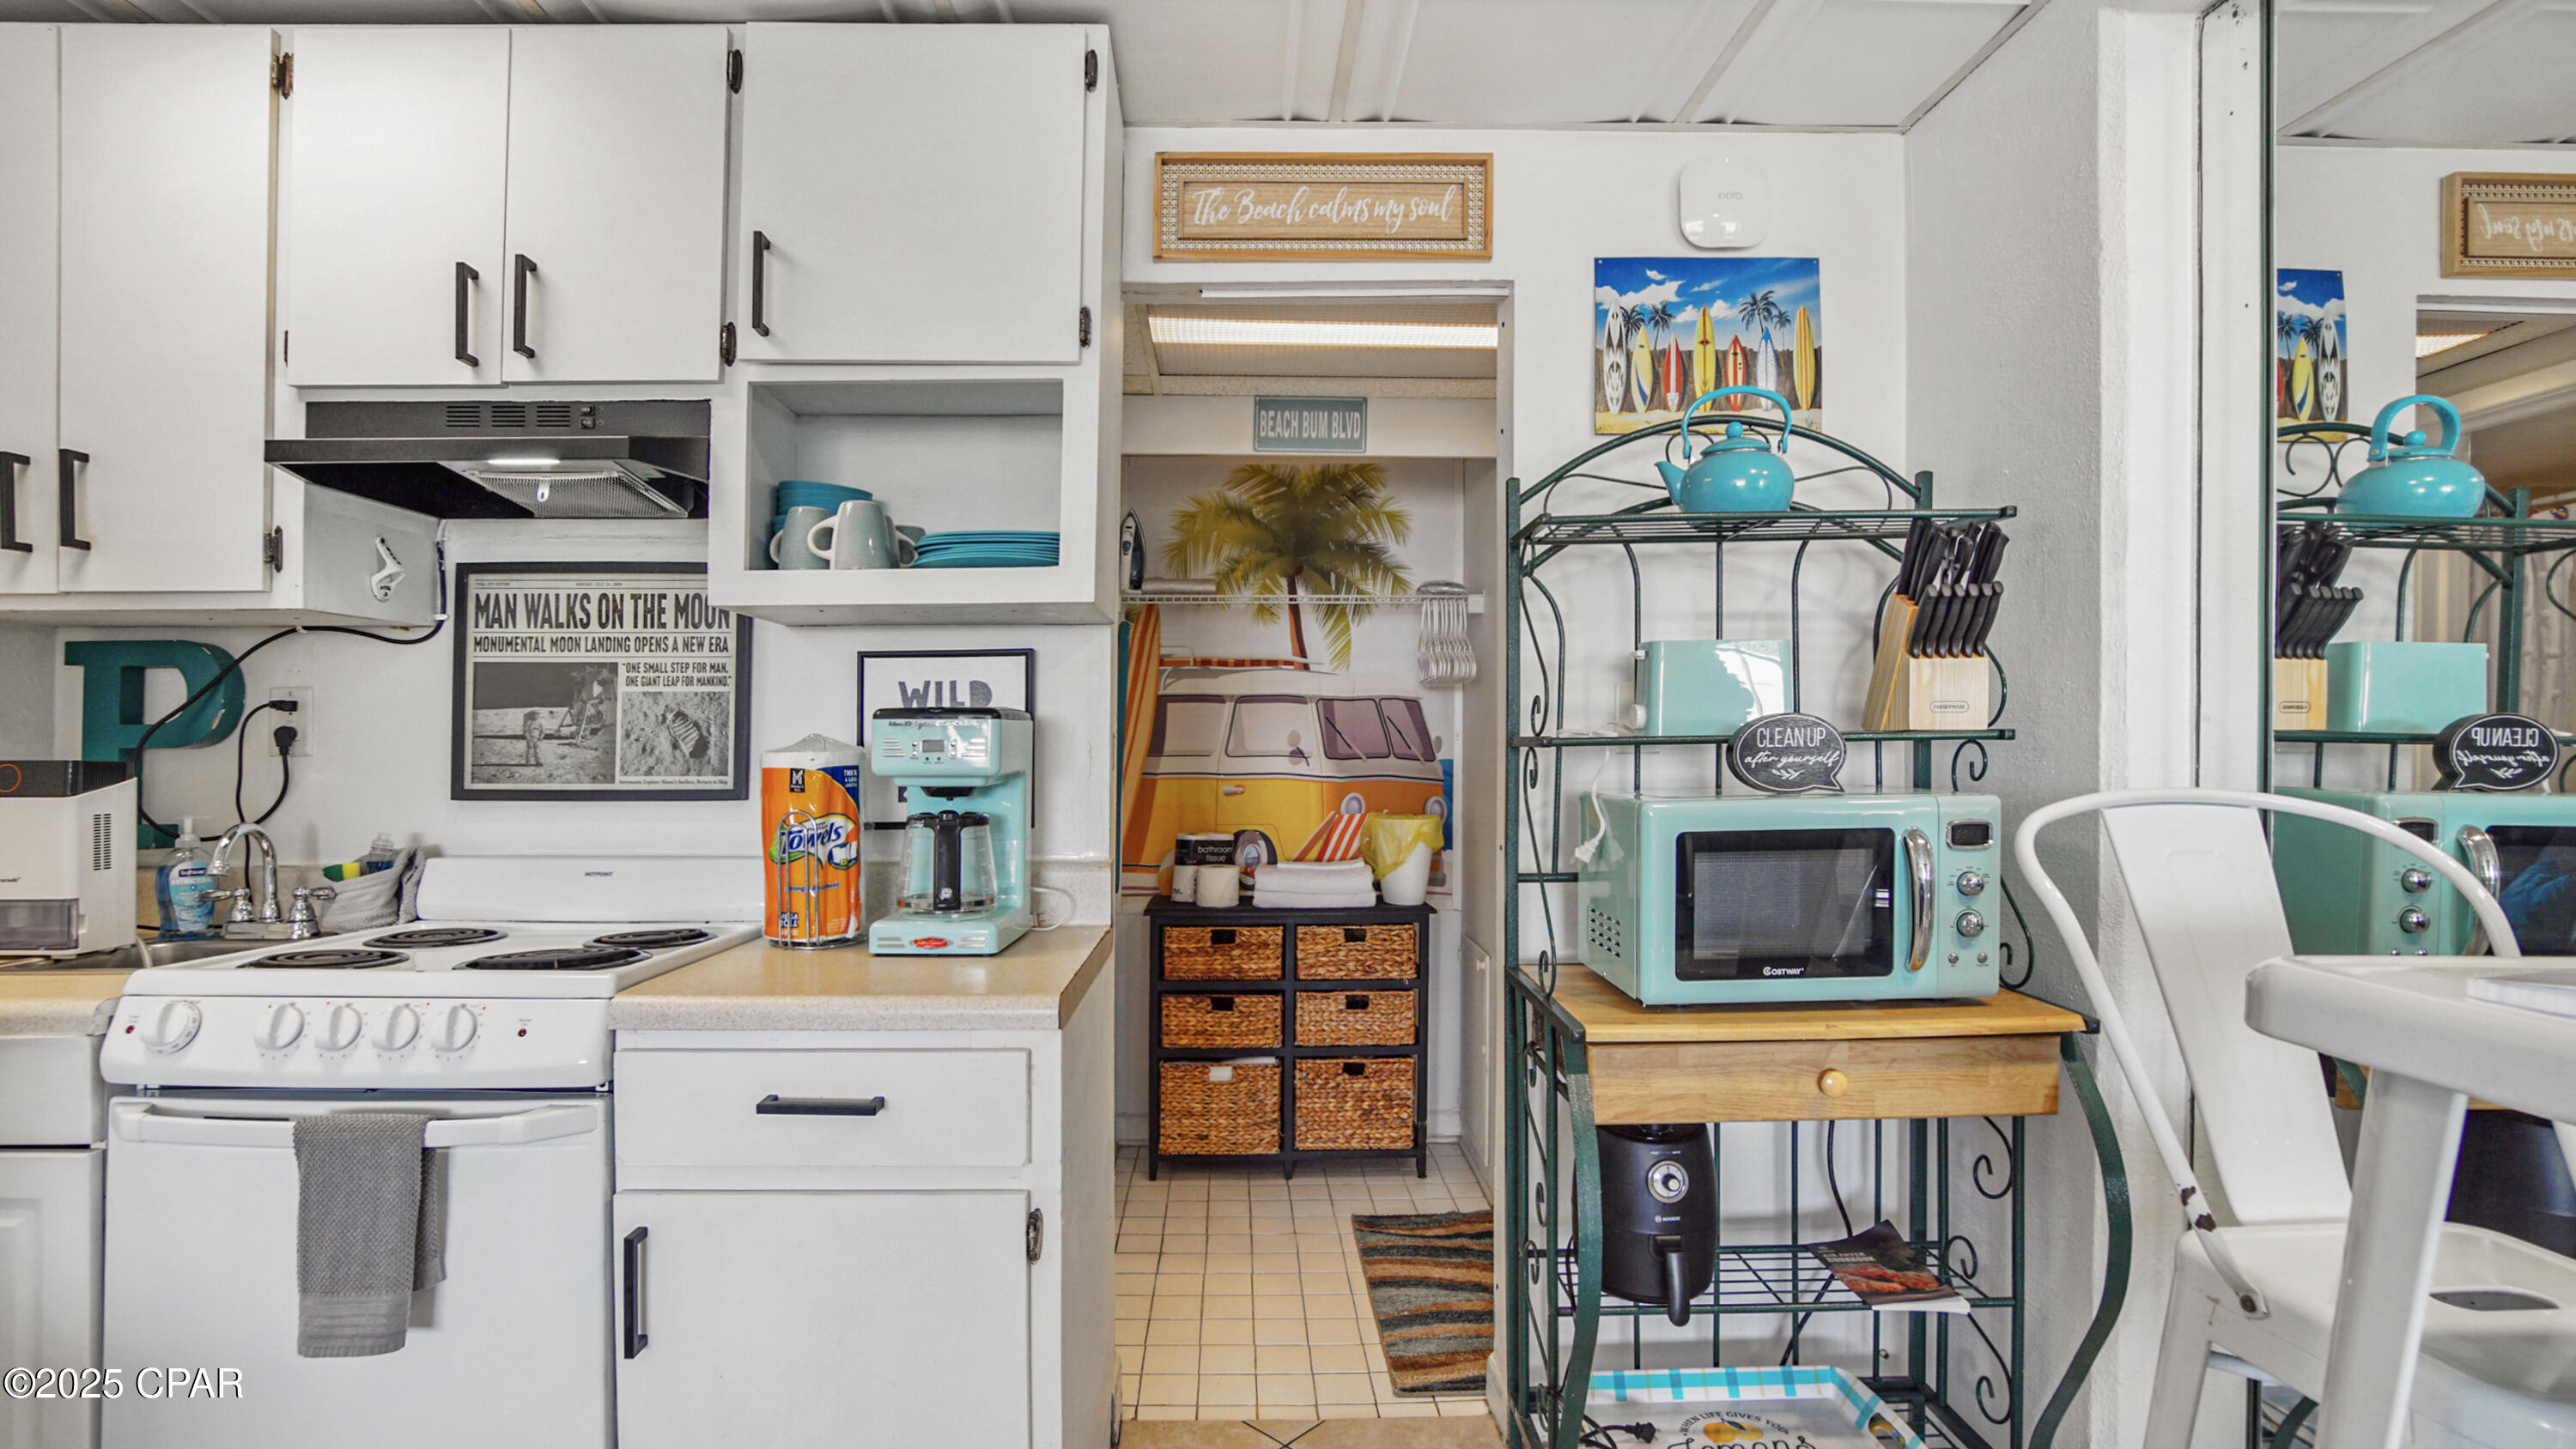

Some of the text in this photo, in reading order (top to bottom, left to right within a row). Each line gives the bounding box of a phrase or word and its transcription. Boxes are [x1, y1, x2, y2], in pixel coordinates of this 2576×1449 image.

[1192, 184, 1455, 234] The Beach calms my soul
[1260, 410, 1361, 439] BEACH BUM BLVD
[474, 592, 730, 629] MAN WALKS ON THE MOON
[473, 636, 729, 652] MONUMENTAL MOON LANDING OPENS A NEW ERA
[643, 662, 669, 674] SMALL
[671, 662, 690, 674] STEP
[692, 662, 708, 674] FOR
[625, 676, 639, 687] ONE
[641, 676, 661, 687] GIANT
[662, 676, 680, 687] LEAP
[681, 676, 695, 687] FOR
[898, 680, 993, 707] WILD
[64, 640, 246, 848] P
[1757, 727, 1826, 748] CLEAN UP
[1744, 750, 1840, 768] after yourself
[1680, 1416, 1701, 1434] WHEN
[1699, 1411, 1724, 1420] LIFE
[1726, 1411, 1762, 1422] GIVES
